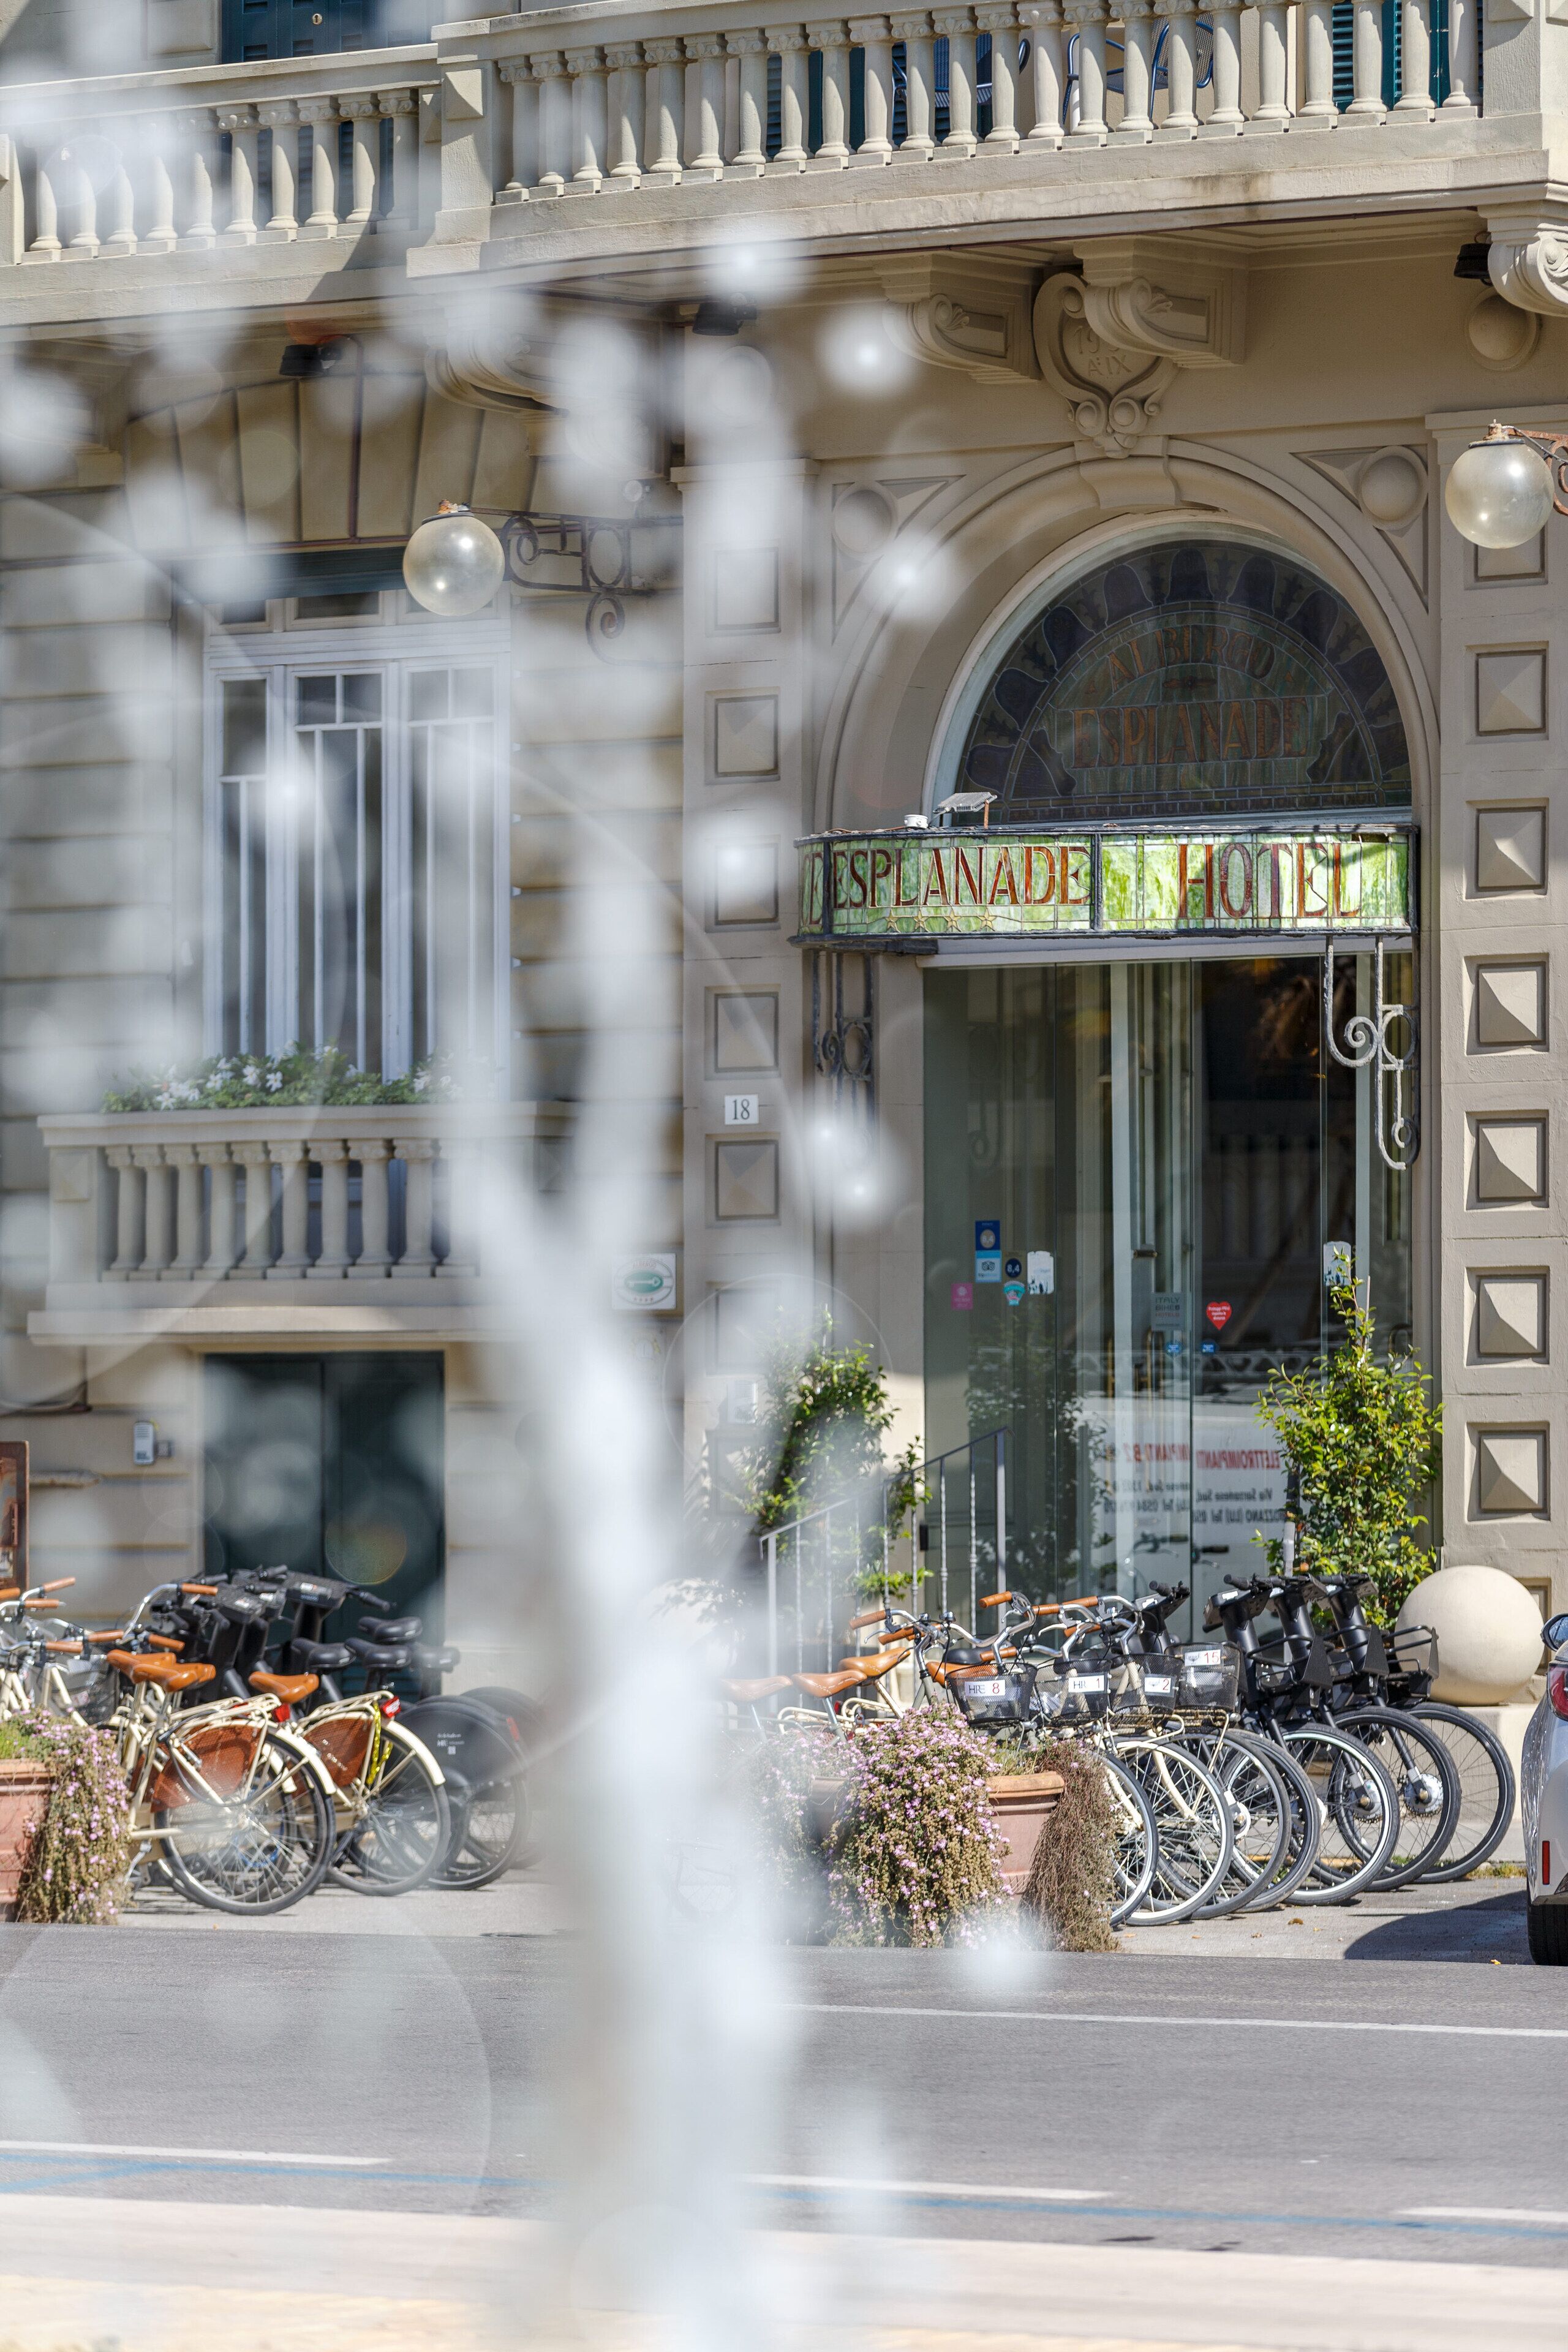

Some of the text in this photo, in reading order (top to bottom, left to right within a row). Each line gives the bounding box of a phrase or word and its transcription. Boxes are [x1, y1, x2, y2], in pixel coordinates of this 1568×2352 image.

[1107, 625, 1276, 693] ALBERGO
[1072, 696, 1310, 769] ESPLANADE
[832, 842, 1361, 919] ESPLANADE HOTEL
[732, 1098, 750, 1120] 18
[1204, 1651, 1219, 1664] 15
[992, 1682, 1000, 1694] 8
[1096, 1678, 1100, 1689] 1
[1162, 1678, 1170, 1691] 2
